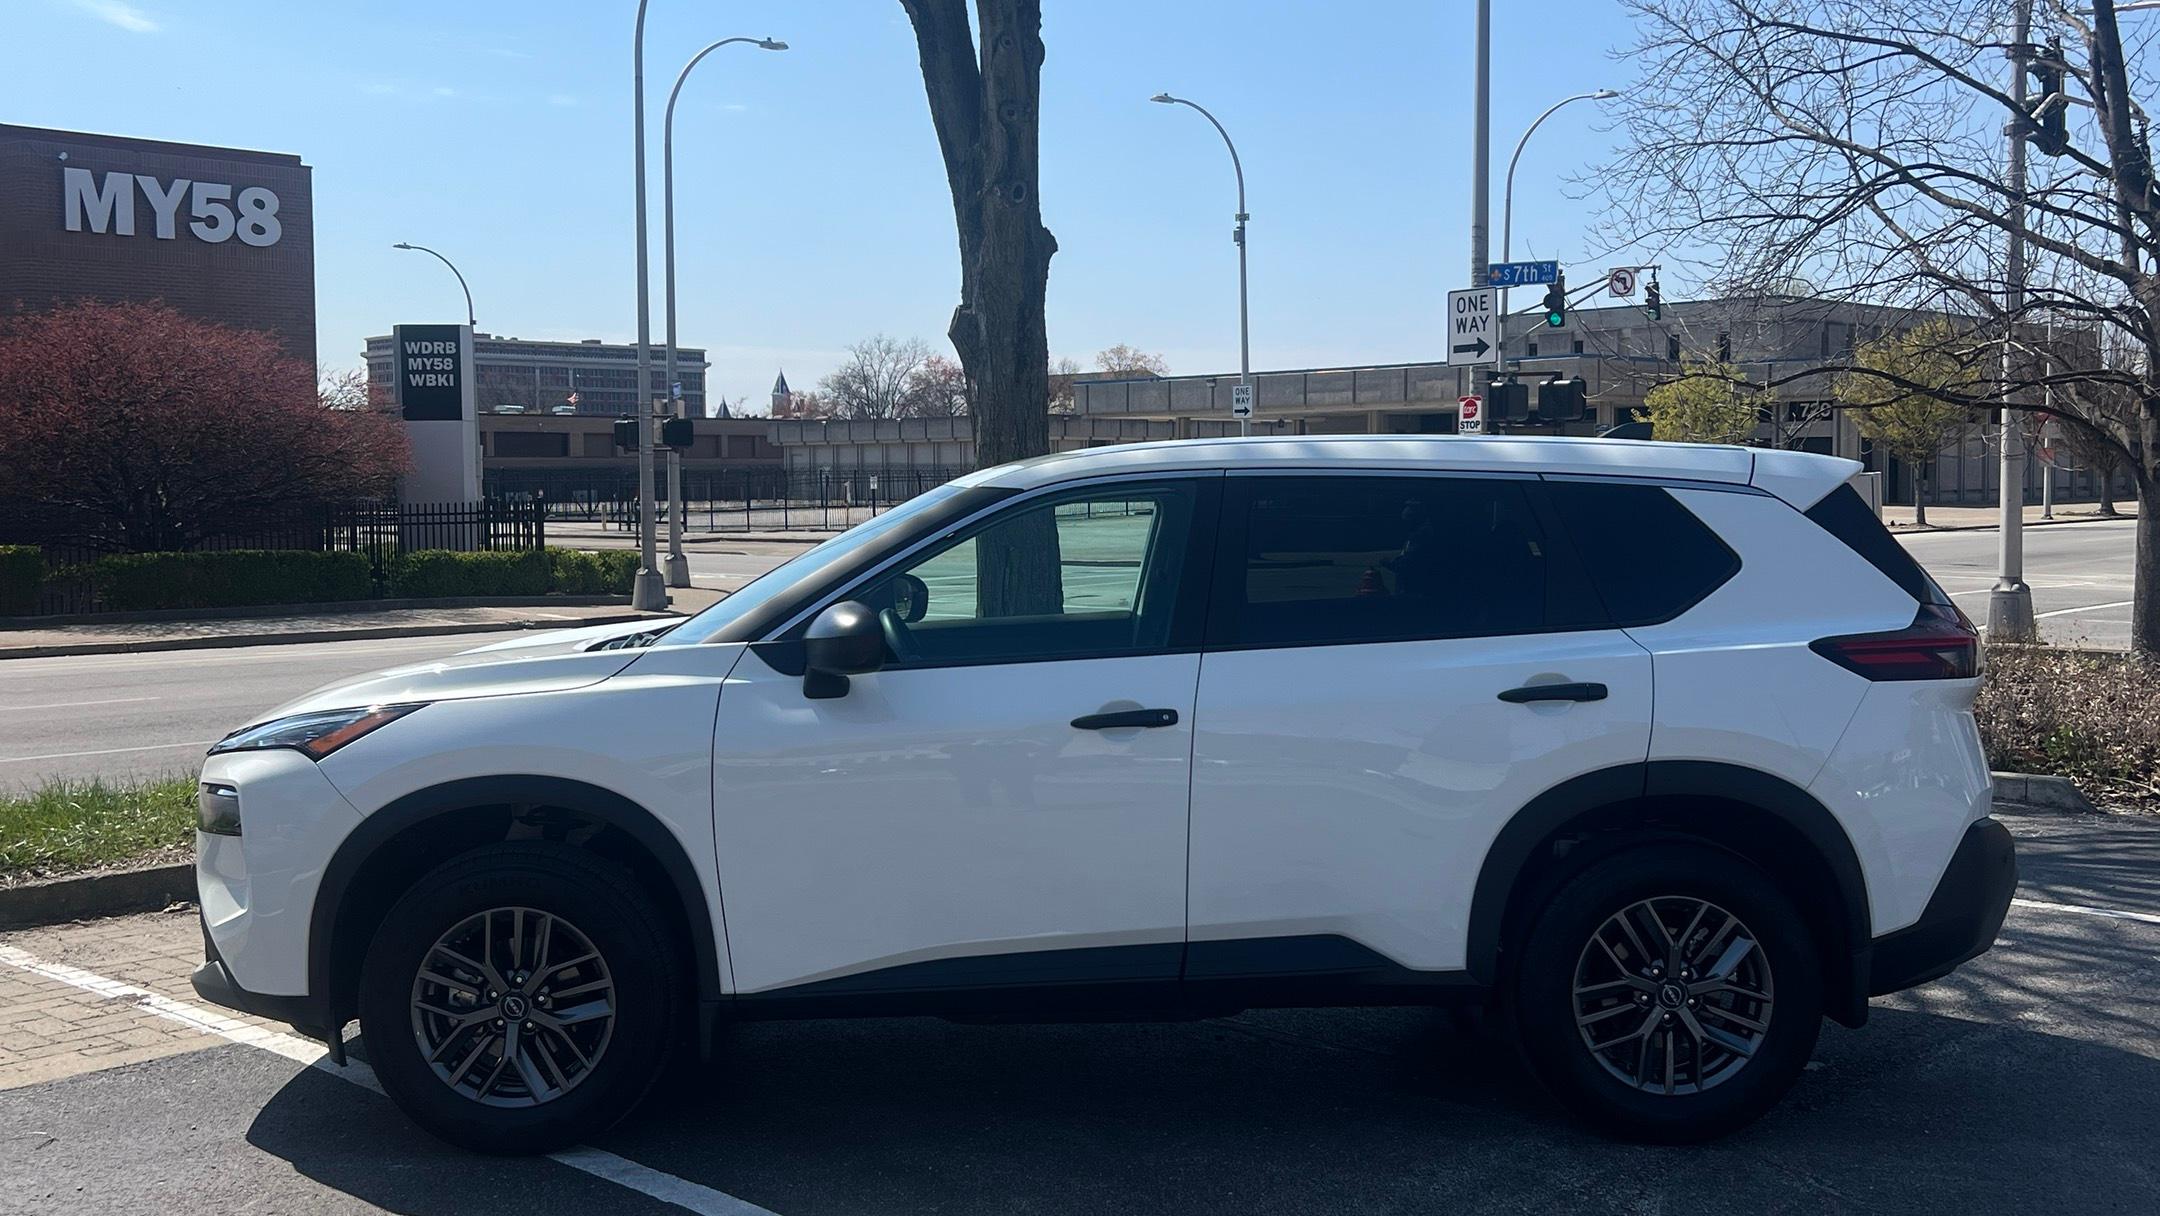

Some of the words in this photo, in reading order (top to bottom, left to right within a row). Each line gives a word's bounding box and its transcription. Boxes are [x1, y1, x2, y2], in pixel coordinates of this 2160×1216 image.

[64, 167, 282, 247] MY58
[1504, 269, 1511, 281] S
[1513, 265, 1537, 282] 7th
[1542, 264, 1551, 272] St
[1457, 294, 1489, 313] ONE
[1456, 314, 1489, 334] WAY
[405, 341, 456, 354] WDRB
[408, 358, 453, 370] MY58
[409, 374, 454, 387] WBKI
[1235, 387, 1249, 396] ONE
[1235, 396, 1249, 405] WAY
[1460, 420, 1481, 429] STOP
